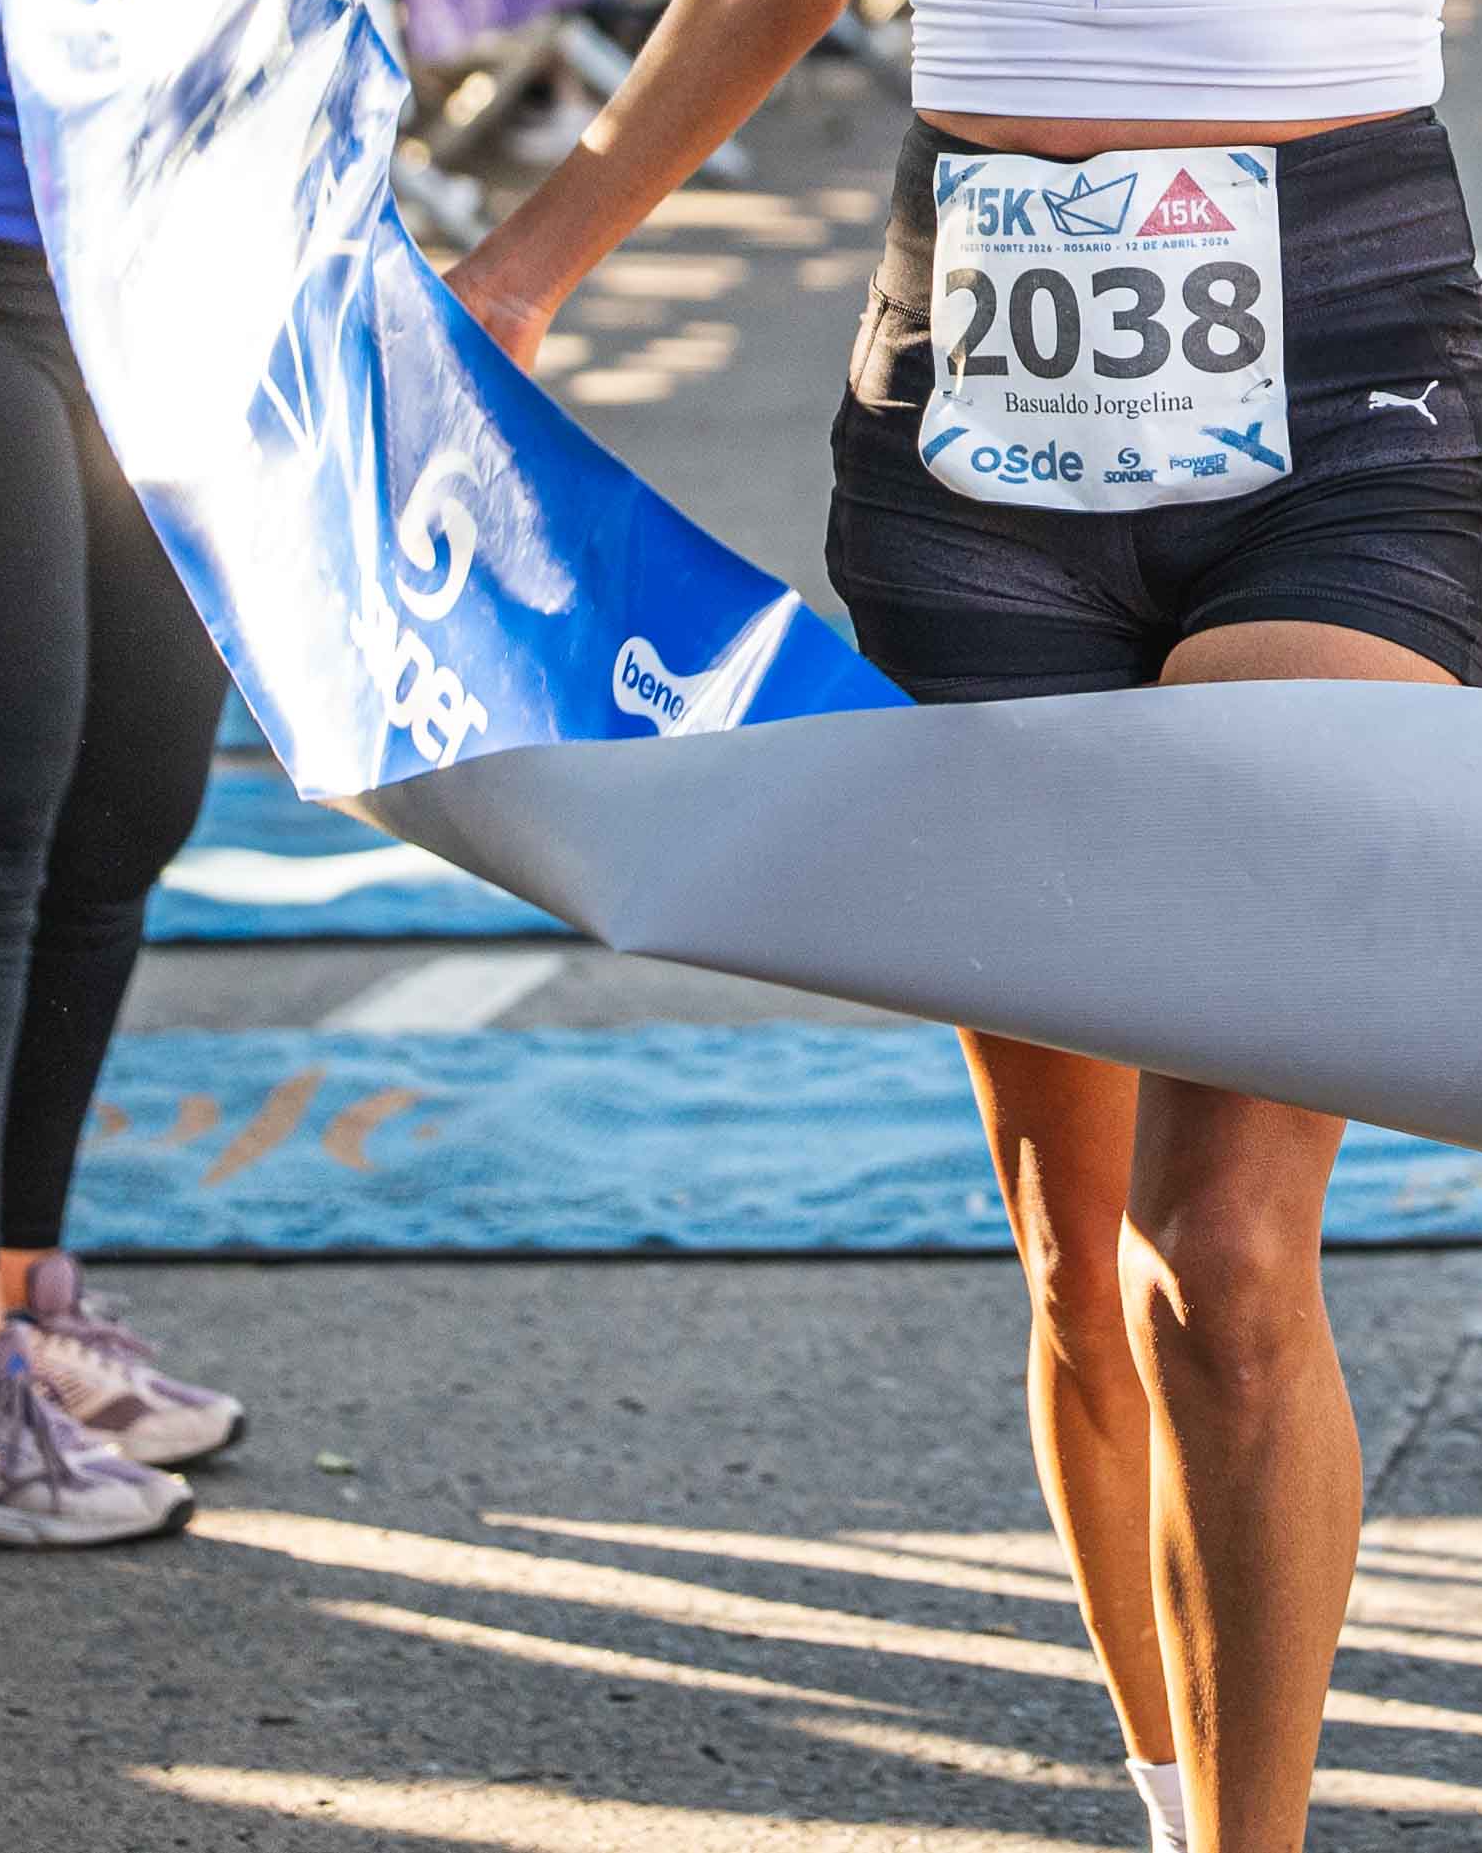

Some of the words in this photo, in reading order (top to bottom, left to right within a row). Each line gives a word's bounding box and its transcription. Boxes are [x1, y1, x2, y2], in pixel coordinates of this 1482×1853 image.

[965, 188, 1036, 237] 15K
[1158, 199, 1211, 228] 15K
[993, 243, 1025, 253] NORTE
[1028, 243, 1053, 253] 2026
[1064, 242, 1111, 253] ROSARIO
[1125, 242, 1138, 252] 12
[1142, 240, 1158, 251] DE
[1162, 238, 1197, 250] ABRIL
[1201, 236, 1230, 247] 2026
[945, 260, 1266, 379] 2038
[1005, 392, 1089, 415] Basualdo
[1093, 391, 1194, 420] Jorgelina
[971, 439, 1084, 483] osde
[1169, 453, 1228, 470] POWER
